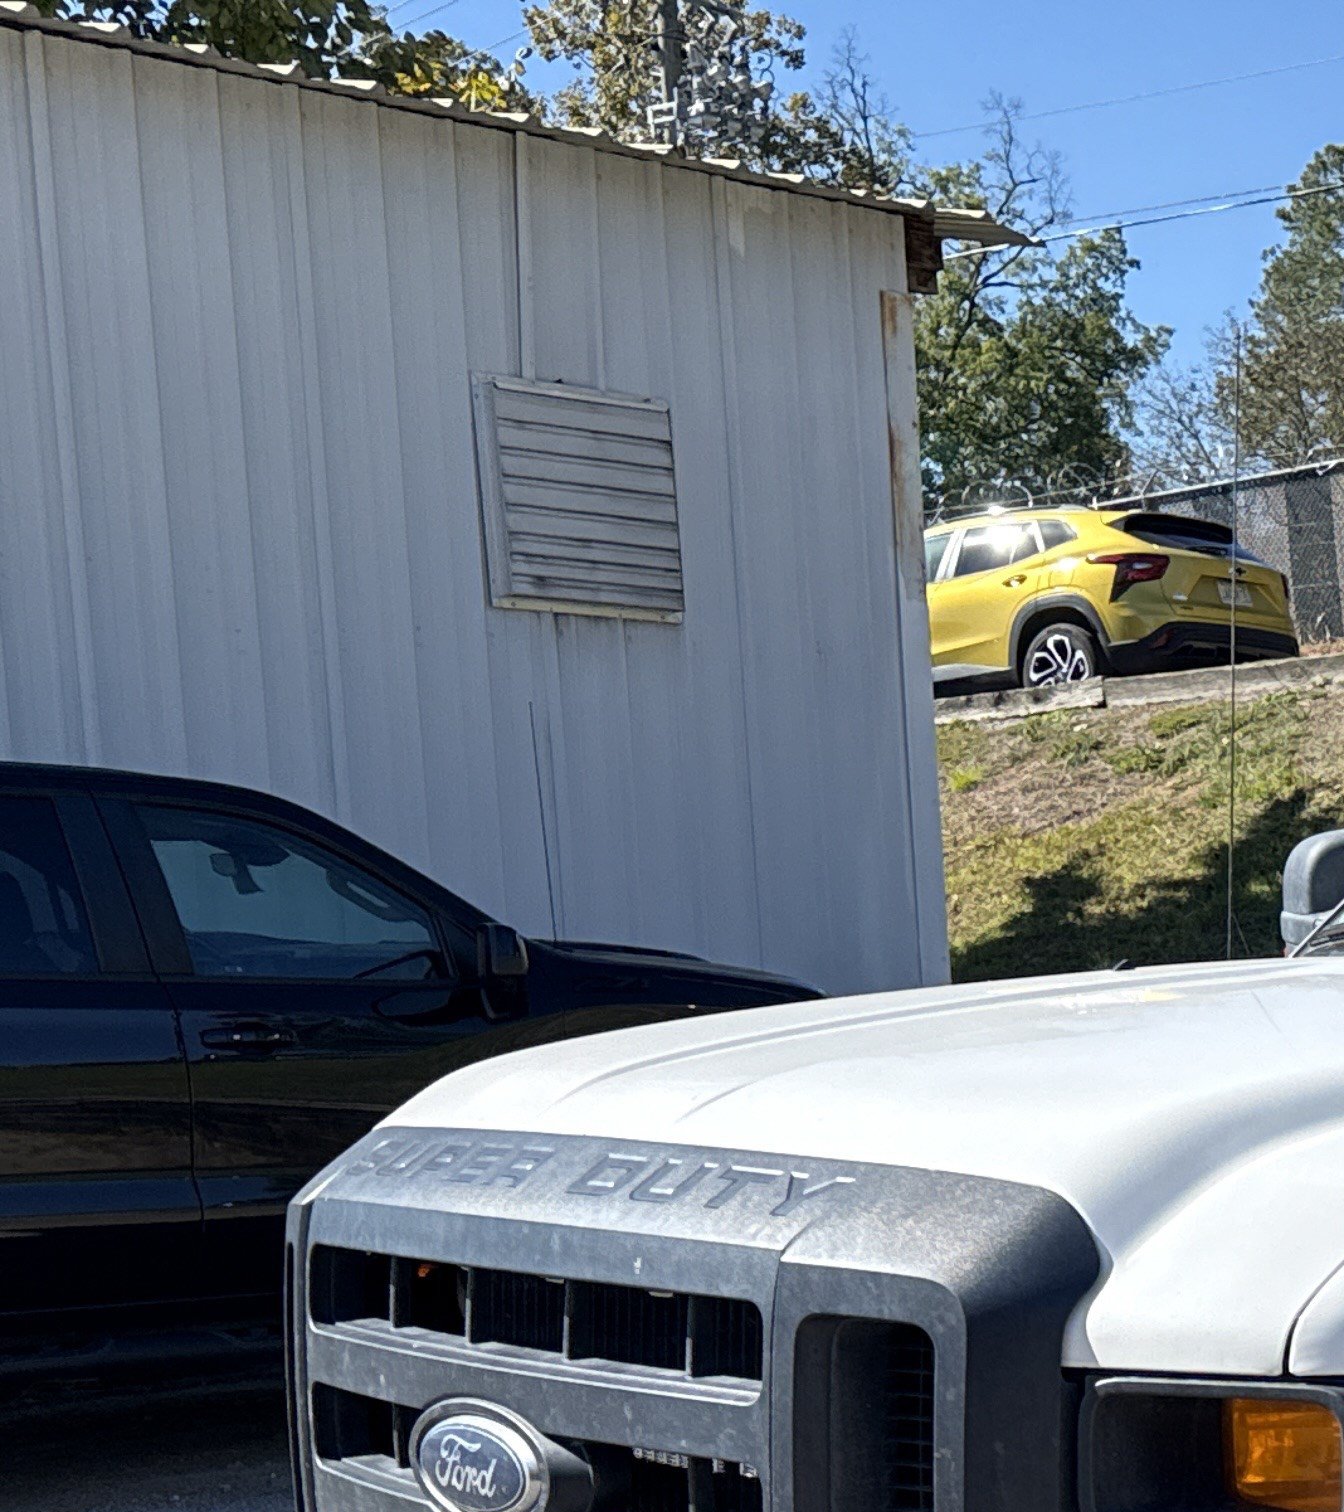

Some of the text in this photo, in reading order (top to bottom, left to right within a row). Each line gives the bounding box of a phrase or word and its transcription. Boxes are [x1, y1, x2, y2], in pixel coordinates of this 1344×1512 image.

[348, 1137, 856, 1217] SUPER DUTY
[434, 1433, 498, 1498] Ford
